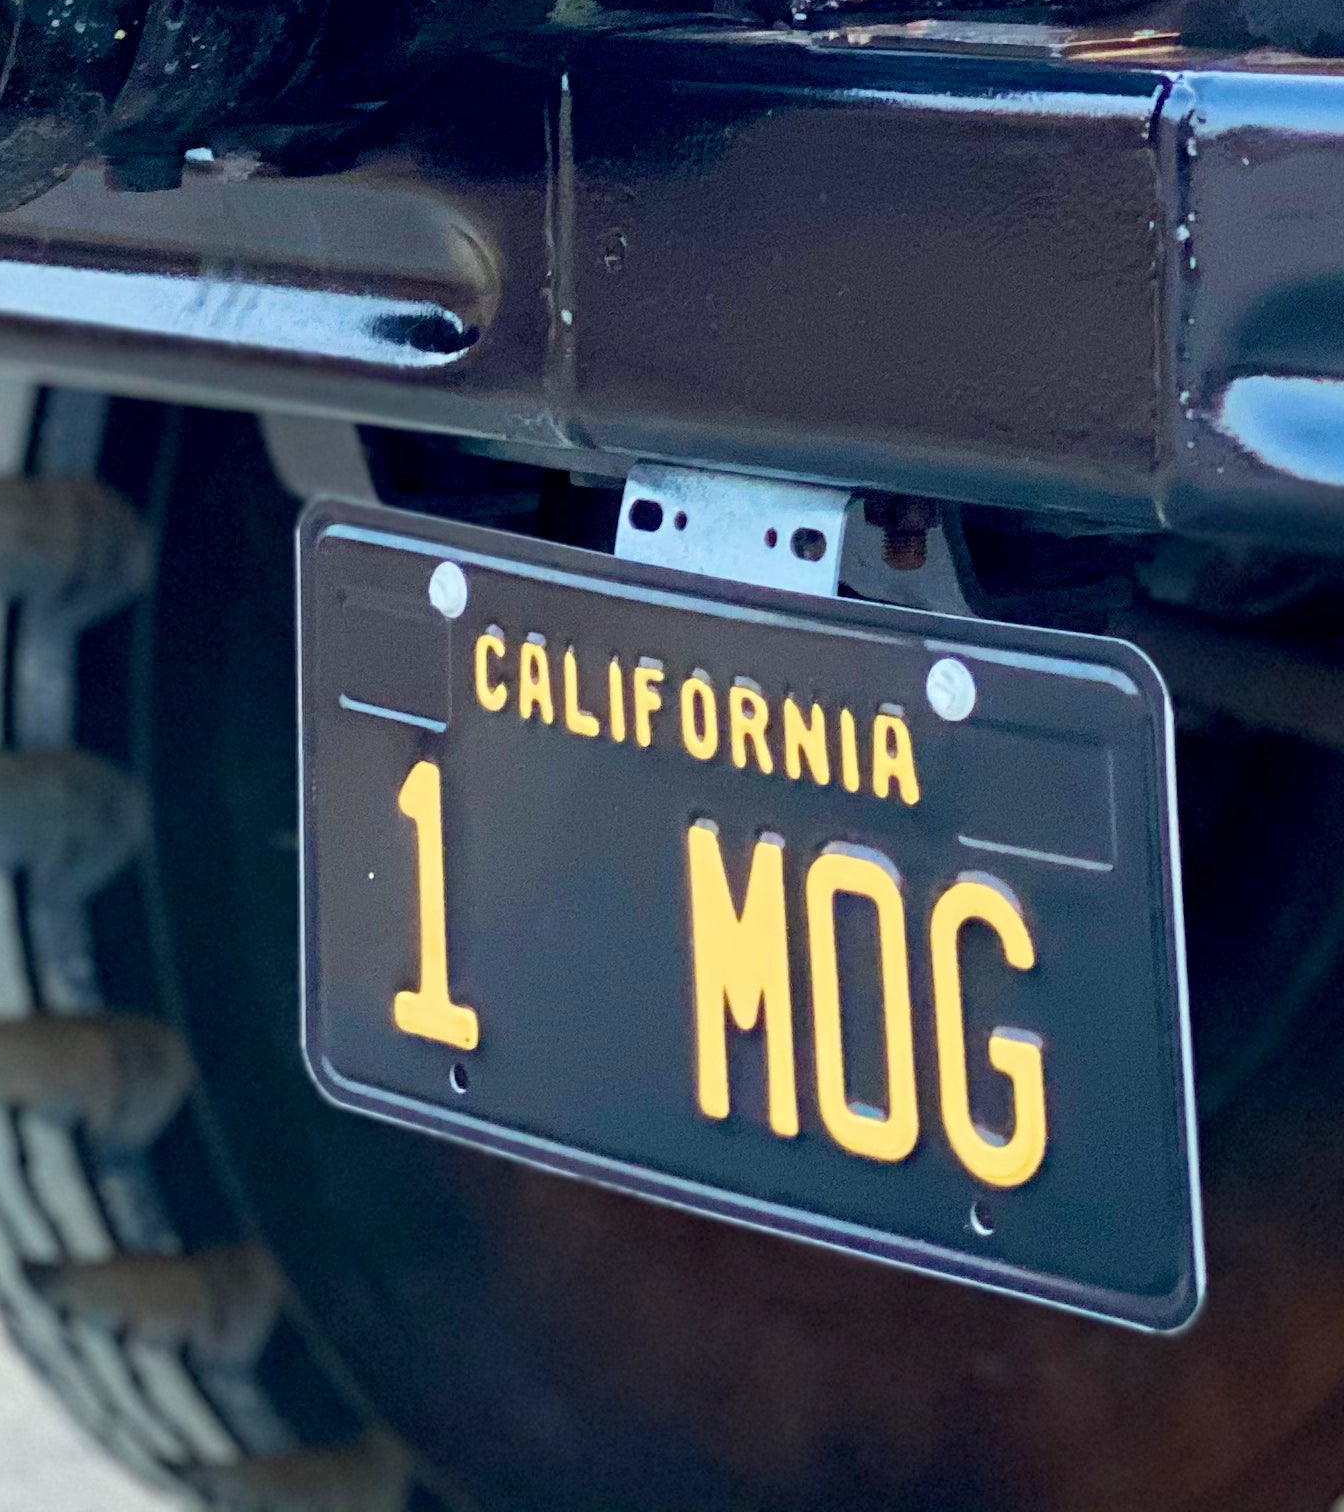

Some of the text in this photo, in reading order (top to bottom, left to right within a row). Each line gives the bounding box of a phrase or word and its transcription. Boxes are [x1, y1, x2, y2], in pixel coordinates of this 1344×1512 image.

[473, 630, 921, 806] CALIFORNIA
[392, 760, 1048, 1189] 1 MOG
